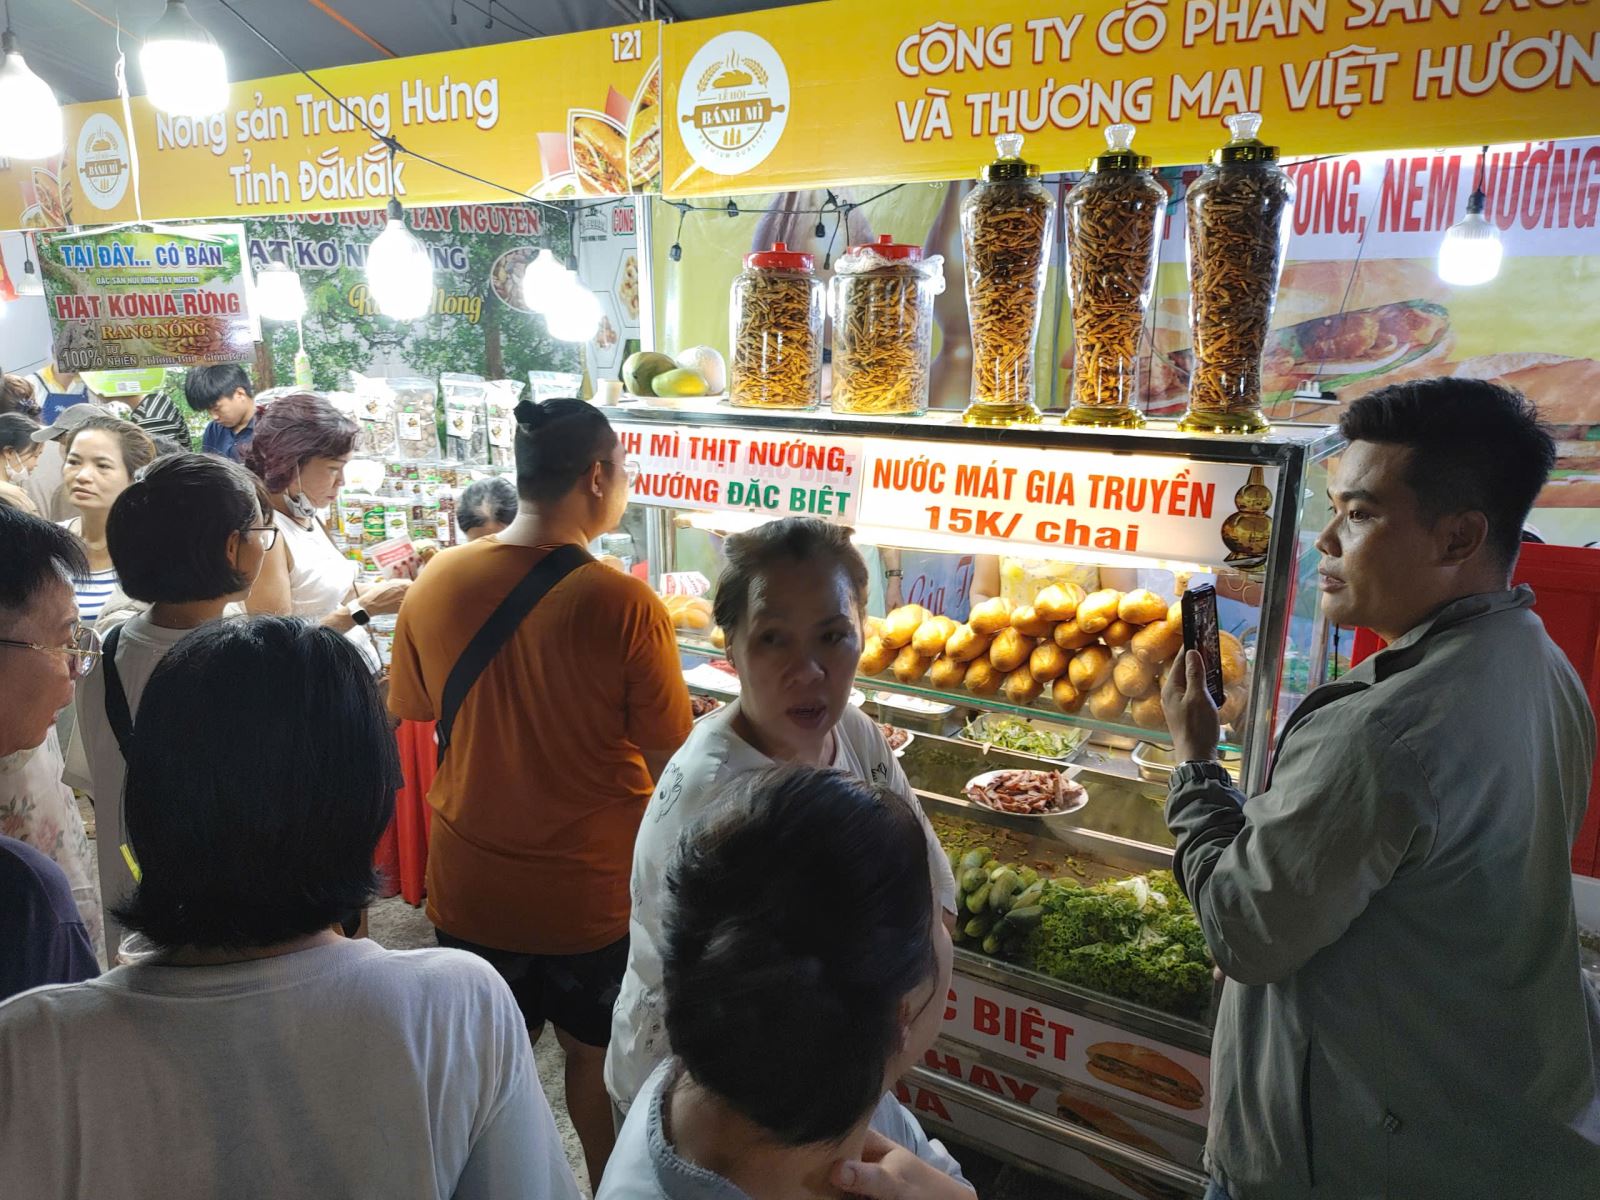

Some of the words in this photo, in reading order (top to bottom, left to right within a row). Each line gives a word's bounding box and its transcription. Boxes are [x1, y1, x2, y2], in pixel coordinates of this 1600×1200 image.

[611, 29, 642, 62] 121
[897, 21, 1012, 76] CÔNG
[1026, 14, 1084, 63] TY
[236, 92, 289, 143] sản
[296, 92, 392, 142] Trung
[402, 76, 499, 130] Hưng
[701, 106, 741, 126] BÁNH
[745, 100, 764, 121] MÌ
[896, 88, 953, 142] VÀ
[965, 77, 1154, 137] THƯƠNG
[1169, 65, 1263, 127] MẠI
[1281, 44, 1400, 118] VIỆT
[230, 149, 290, 205] Tỉnh
[1377, 155, 1462, 233] NEM
[458, 202, 542, 236] NGUYÊN
[61, 246, 93, 272] TẠI
[98, 241, 151, 268] ĐÂY...
[155, 242, 181, 267] CÓ
[185, 239, 222, 267] BÁN
[295, 237, 341, 268] KƠ
[56, 294, 101, 323] HẠT
[107, 291, 178, 318] KƠNIA
[183, 288, 241, 315] RỪNG
[101, 323, 152, 341] RANG
[156, 319, 207, 339] NÓNG
[62, 348, 103, 369] 100%
[107, 354, 137, 367] NHIÊN
[650, 431, 680, 458] MÌ
[689, 437, 741, 467] THỊT
[748, 439, 853, 477] NƯỚNG,
[634, 472, 719, 504] NƯỚNG
[727, 478, 780, 512] ĐẶC
[789, 485, 851, 519] BIỆT
[872, 454, 946, 494] NƯỚC
[954, 460, 1018, 500] MÁT
[1025, 469, 1075, 506] GIA
[1088, 468, 1216, 519] TRUYỀN
[924, 506, 1023, 539] 15K/
[1035, 518, 1140, 552] chai
[973, 996, 1074, 1061] BIỆT
